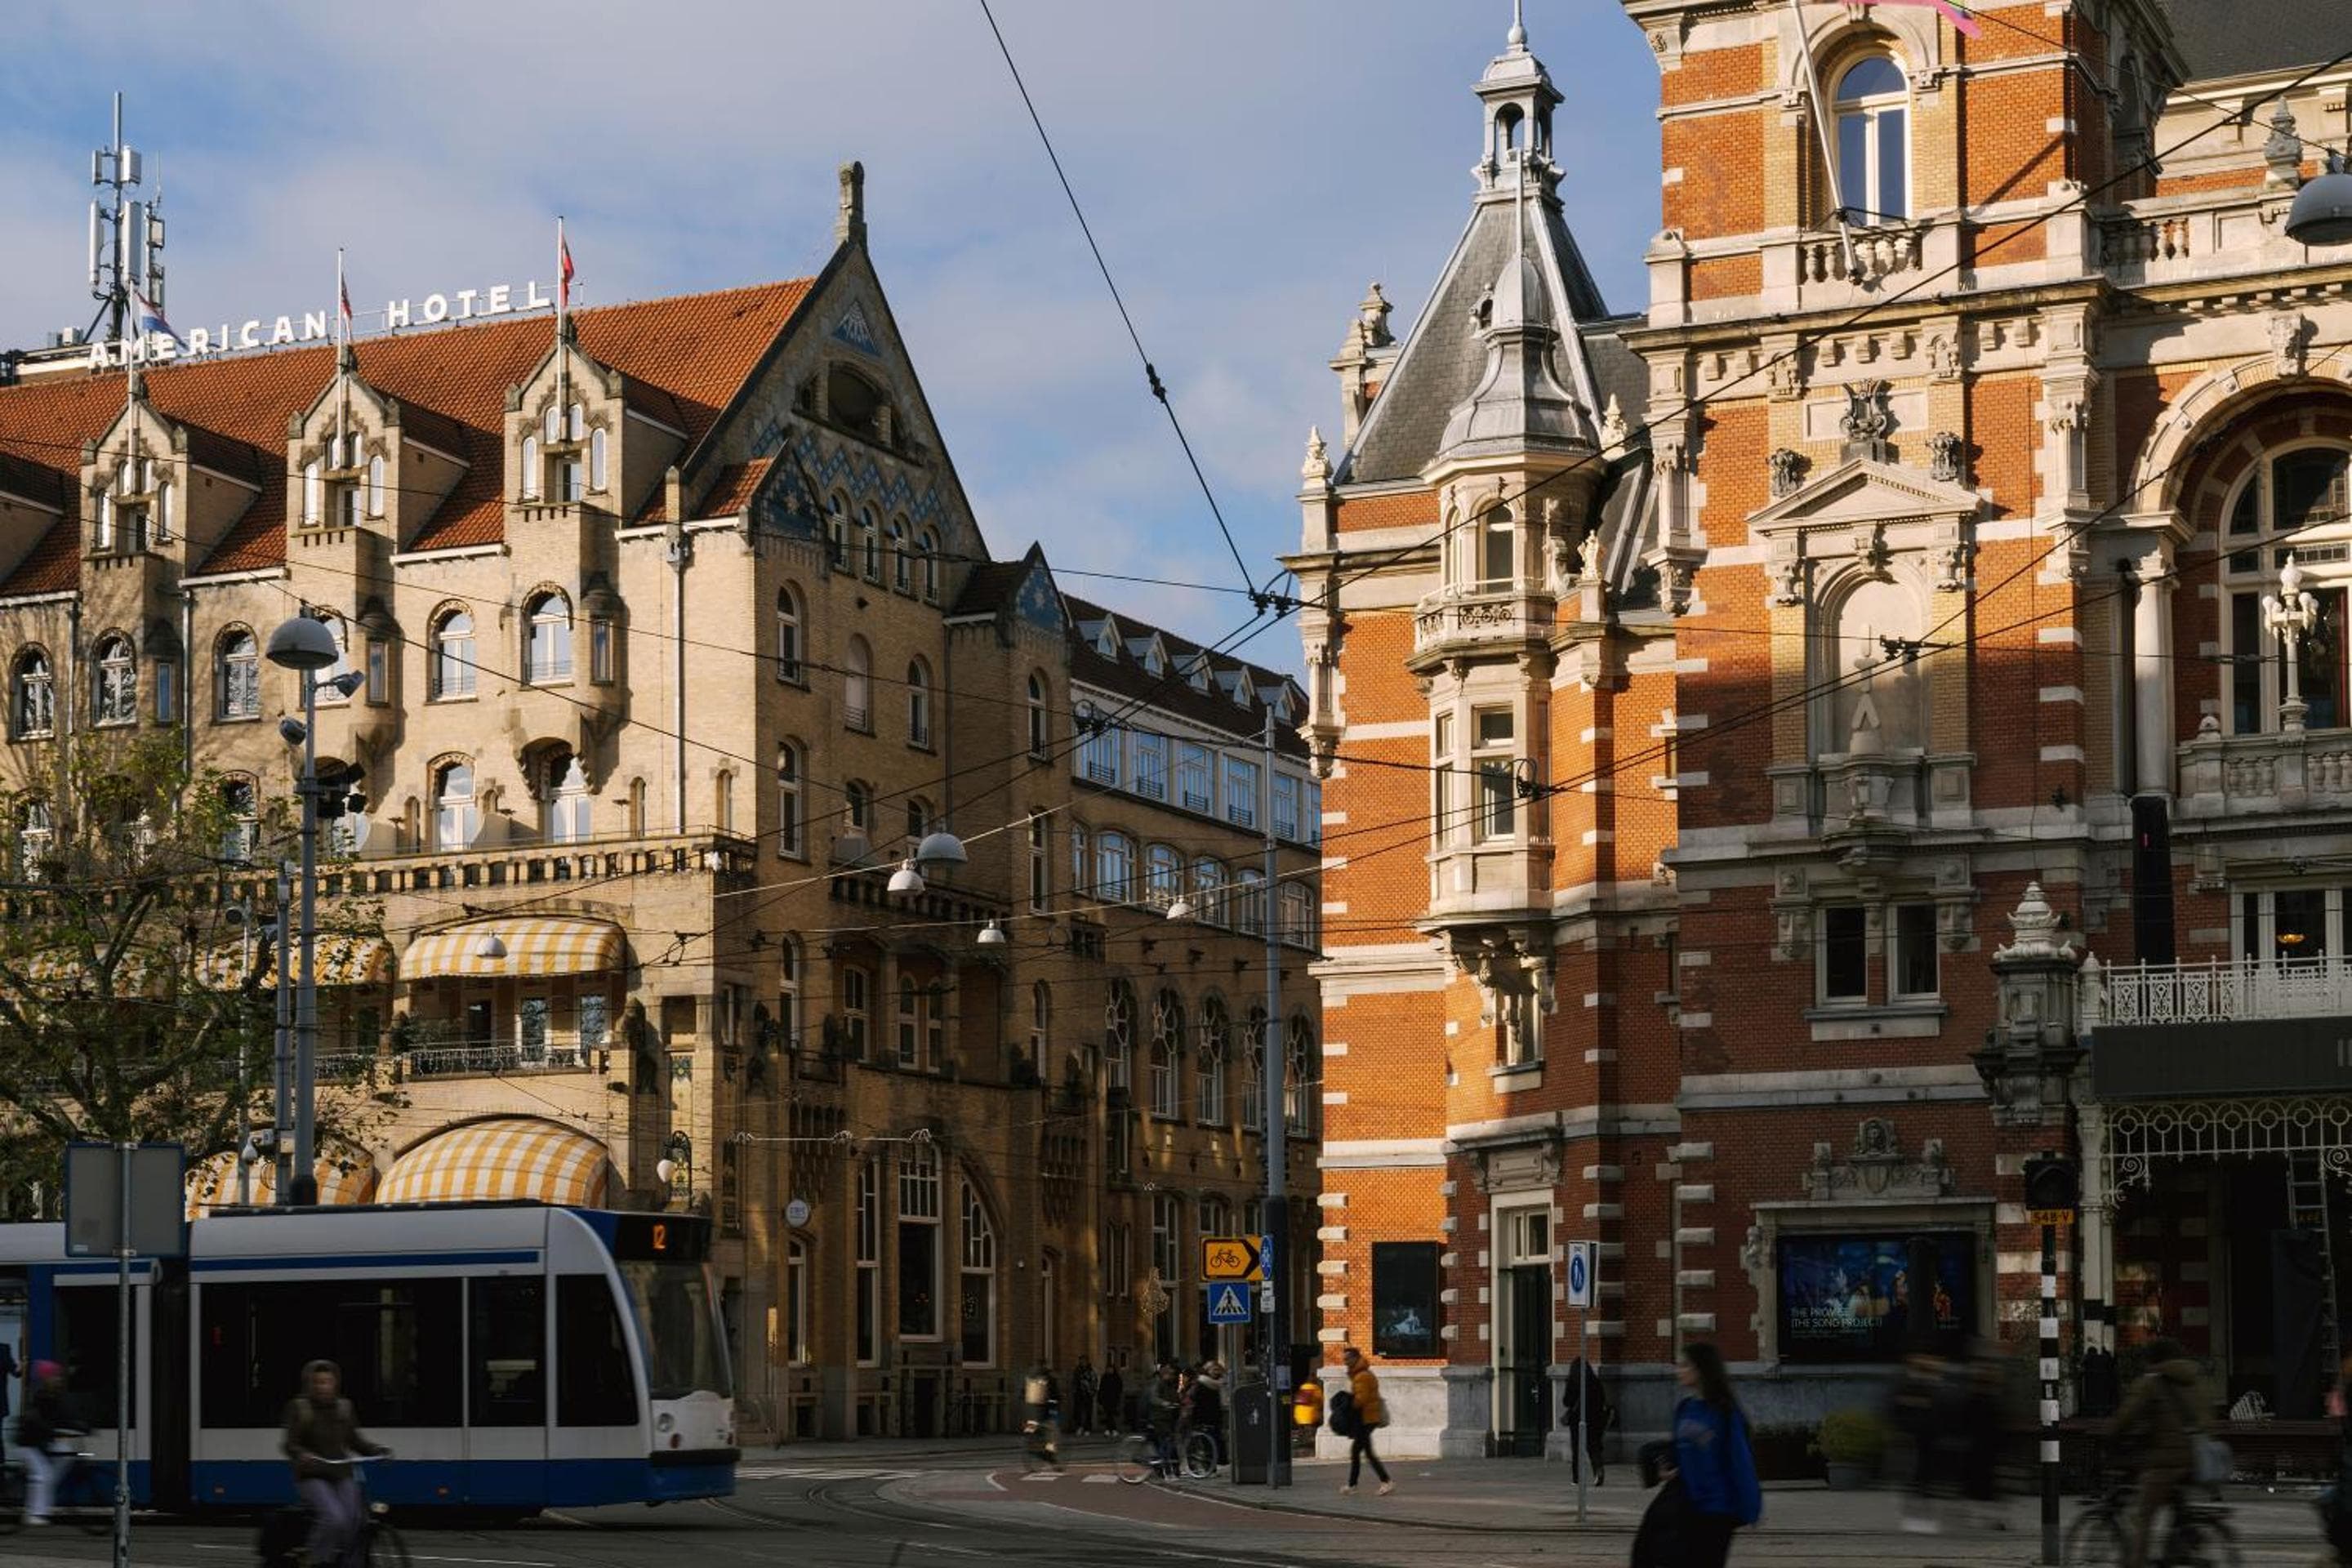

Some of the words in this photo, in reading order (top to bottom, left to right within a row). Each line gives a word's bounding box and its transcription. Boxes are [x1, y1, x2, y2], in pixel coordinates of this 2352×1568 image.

[87, 310, 327, 368] AMERICAN
[389, 280, 551, 327] HOTEL
[1811, 1317, 1839, 1328] SONG
